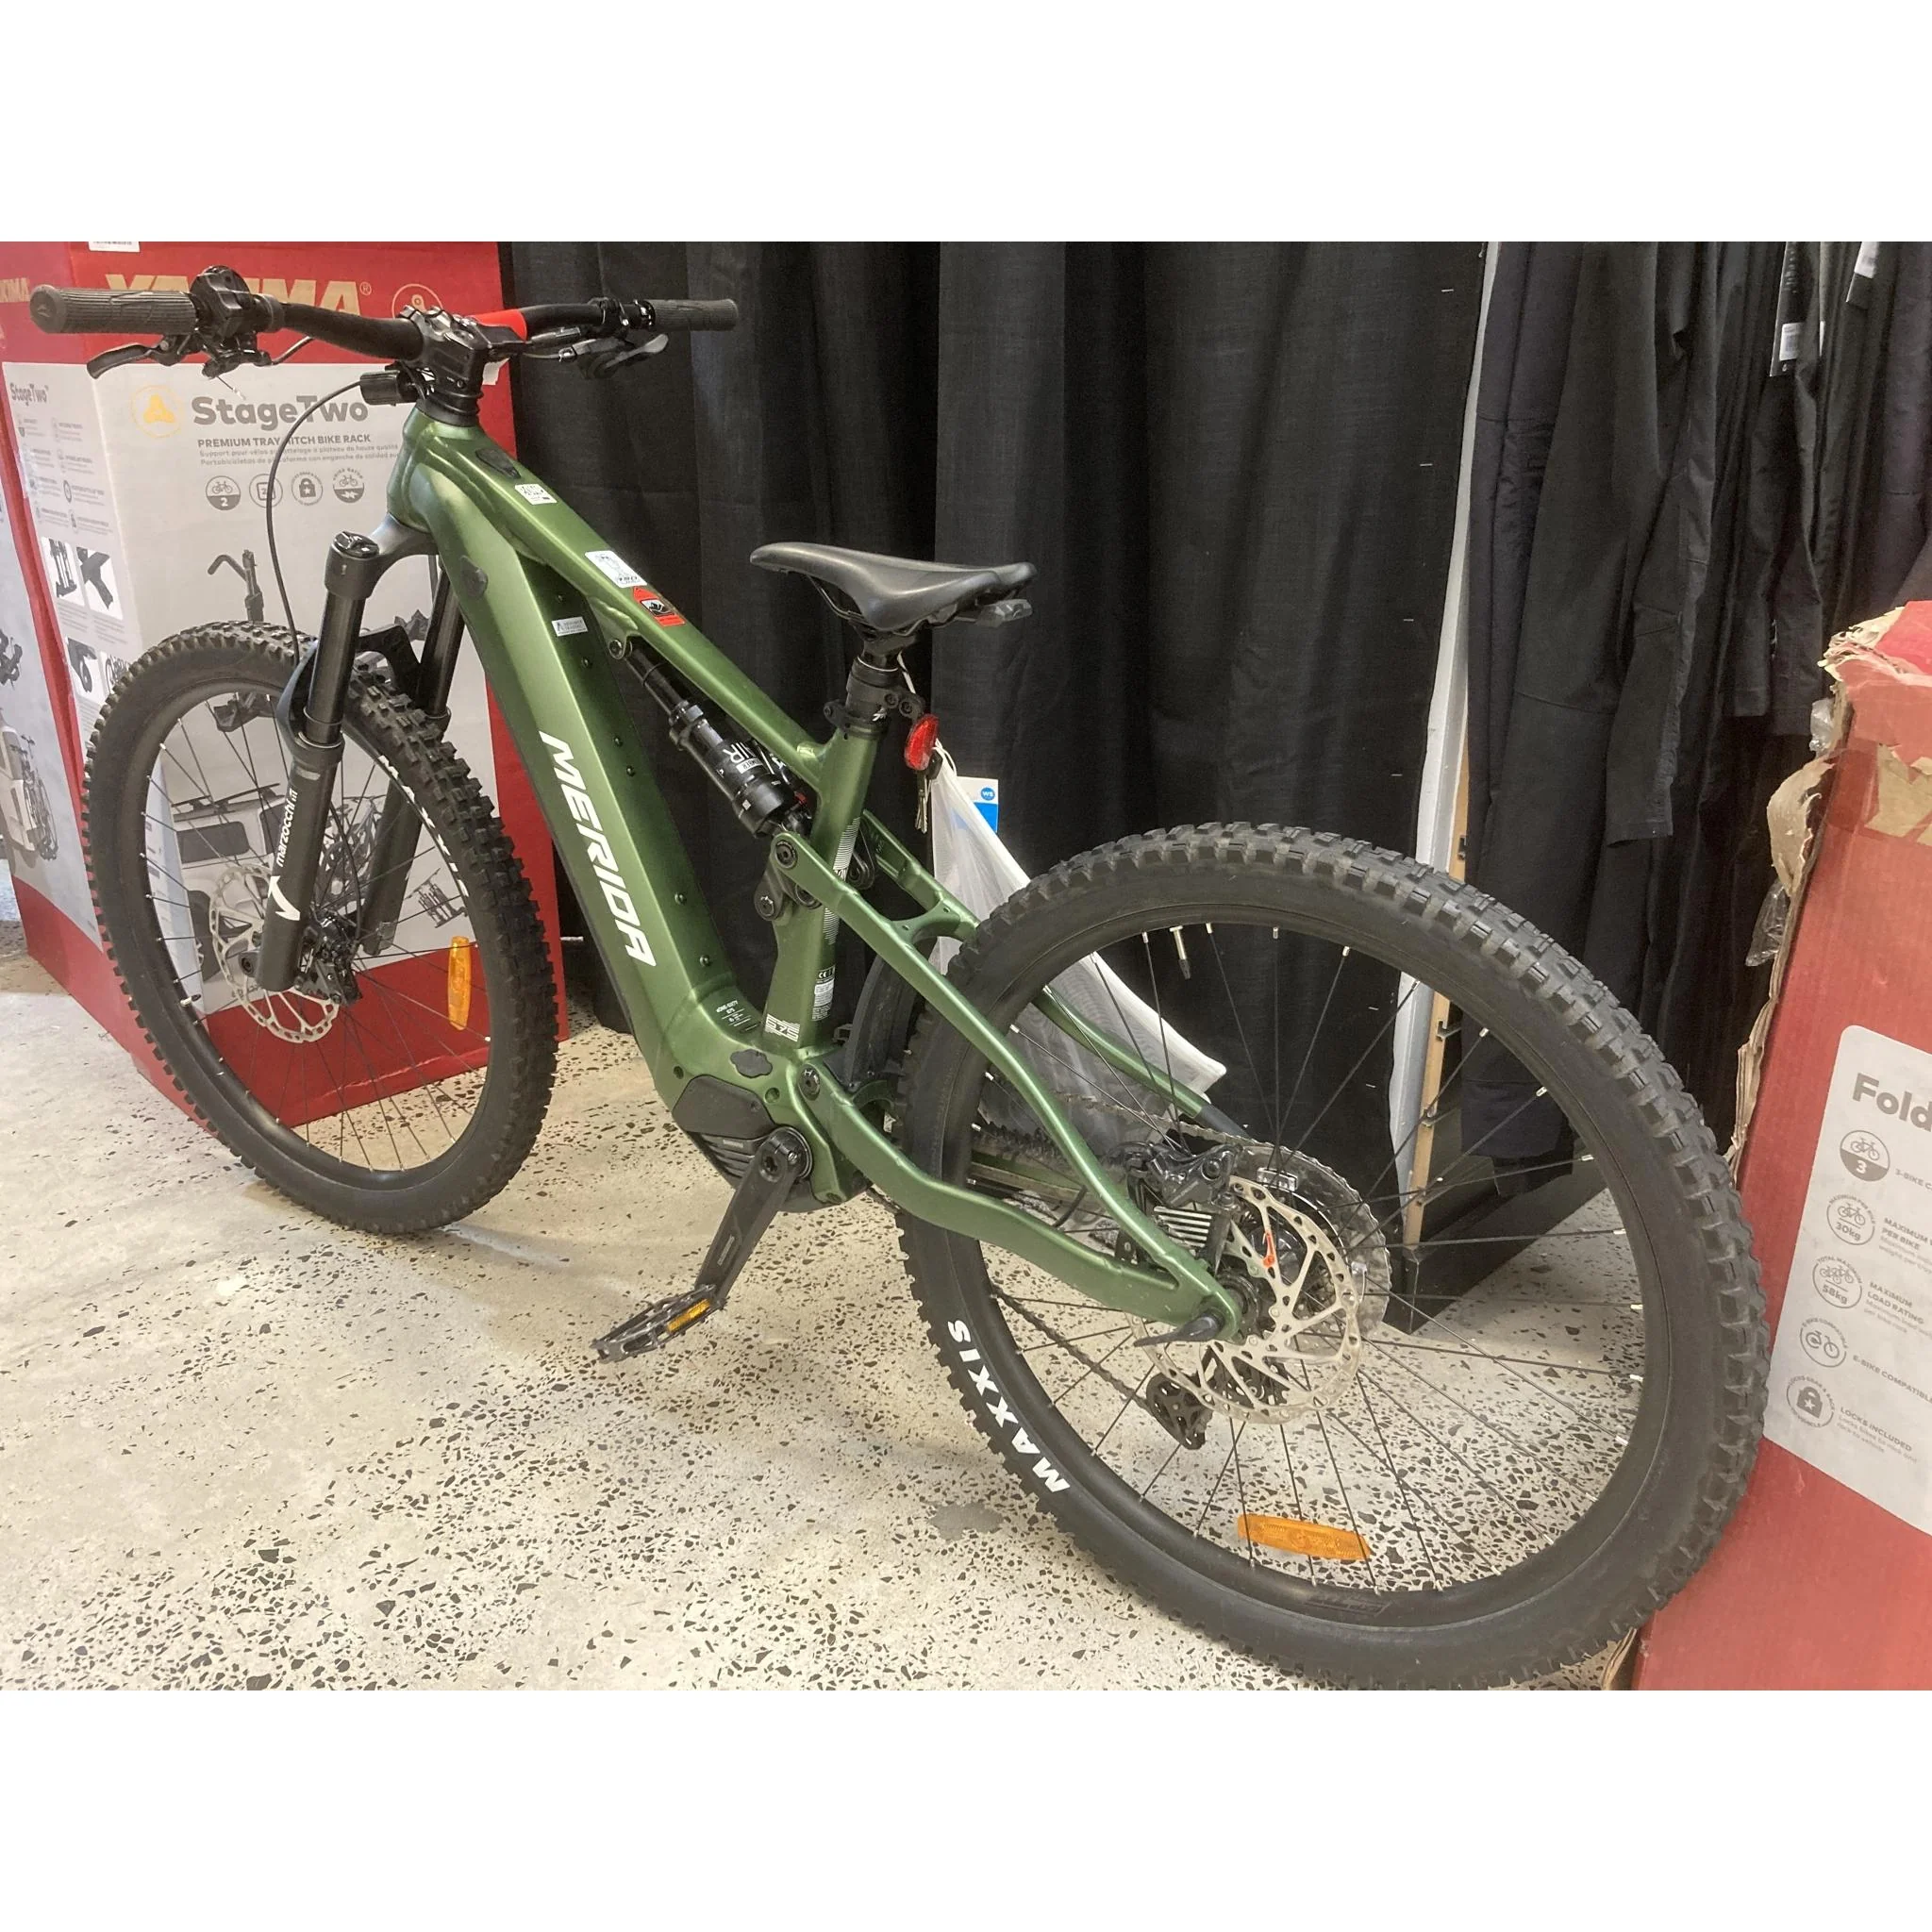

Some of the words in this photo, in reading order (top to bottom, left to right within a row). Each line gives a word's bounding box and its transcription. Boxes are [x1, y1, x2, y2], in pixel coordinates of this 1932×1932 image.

[192, 395, 369, 431] StageTwo
[197, 437, 251, 448] PREMIUM
[253, 437, 280, 446] TRAY
[317, 435, 341, 444] BIKE
[343, 434, 371, 443] RACK
[220, 497, 228, 508] 2
[275, 797, 295, 868] marzocchi
[539, 730, 657, 967] MERIDA
[1852, 1072, 1932, 1133] Fold
[1856, 1158, 1868, 1175] 3
[1835, 1222, 1861, 1241] 30kg
[1881, 1227, 1899, 1240] PER
[1899, 1235, 1921, 1250] BIKE
[1884, 1217, 1928, 1243] MAXIMUM
[1822, 1283, 1848, 1305] 58kg
[1869, 1281, 1913, 1308] MAXIMUM
[1867, 1291, 1890, 1307] LOAD
[1891, 1304, 1924, 1324] RATING
[1852, 1355, 1881, 1374] E-BIKE
[947, 1320, 1071, 1493] MAXXIS
[1840, 1406, 1868, 1427] LOCKS
[1869, 1423, 1913, 1453] INCLUDED
